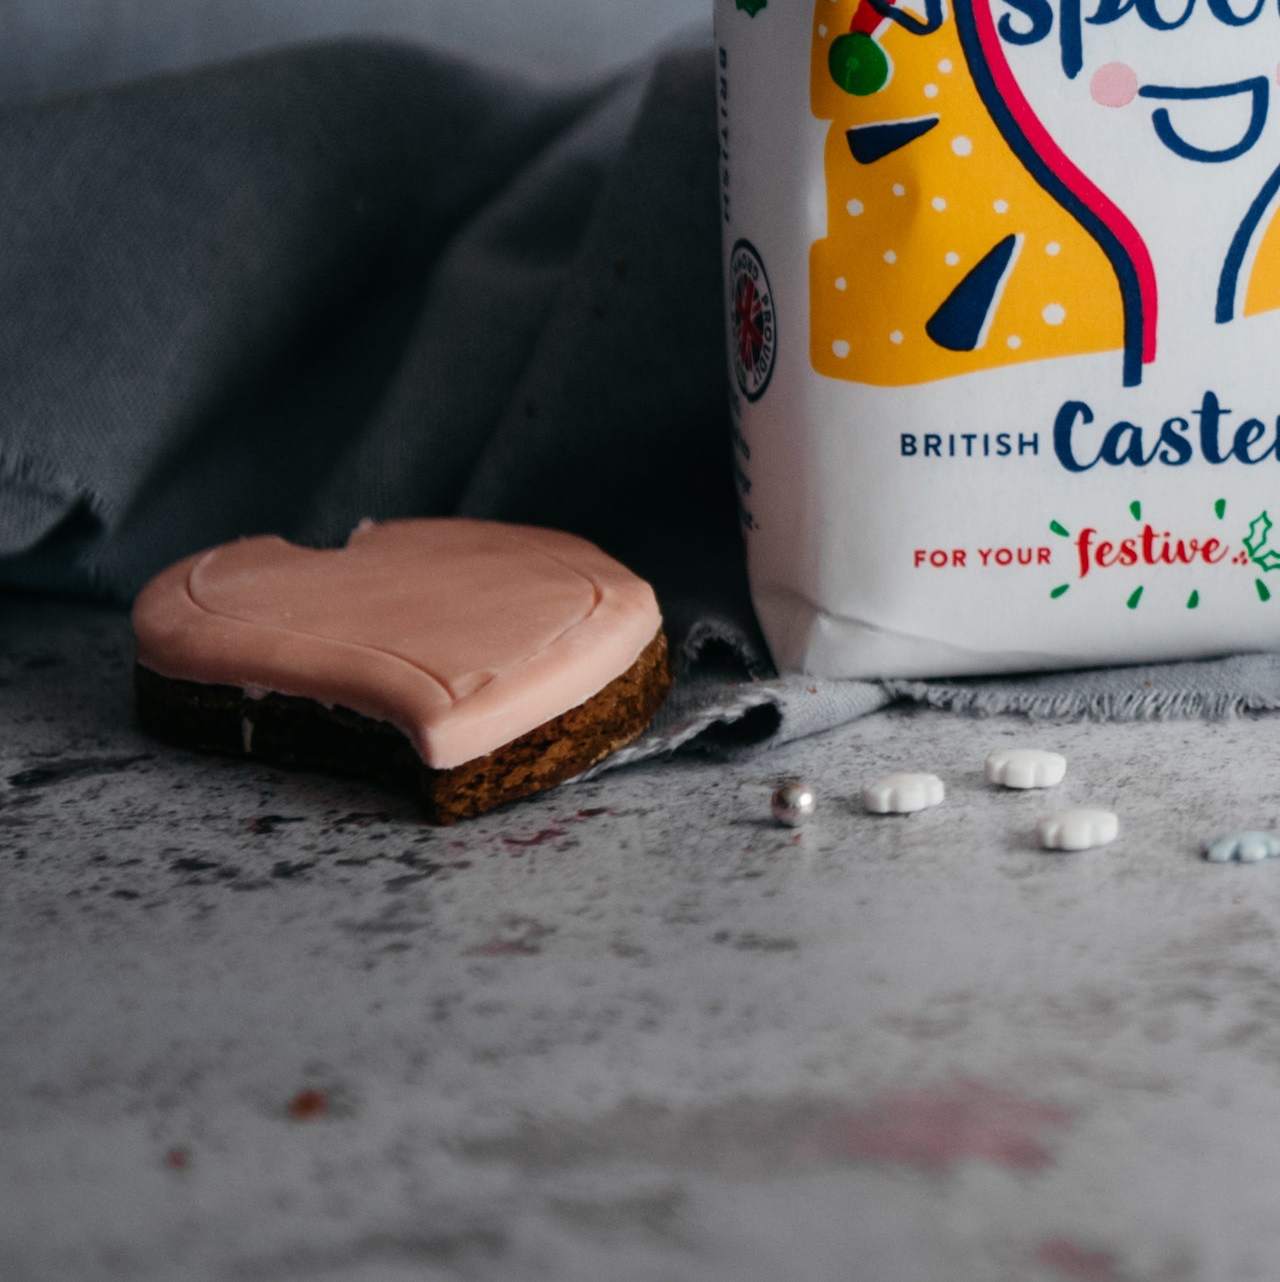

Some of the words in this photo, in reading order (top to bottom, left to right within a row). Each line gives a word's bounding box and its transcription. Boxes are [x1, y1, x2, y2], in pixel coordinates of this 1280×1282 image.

[900, 431, 1040, 458] BRITISH
[914, 548, 967, 568] FOR
[978, 547, 1052, 567] YOUR
[1073, 523, 1230, 579] festive
